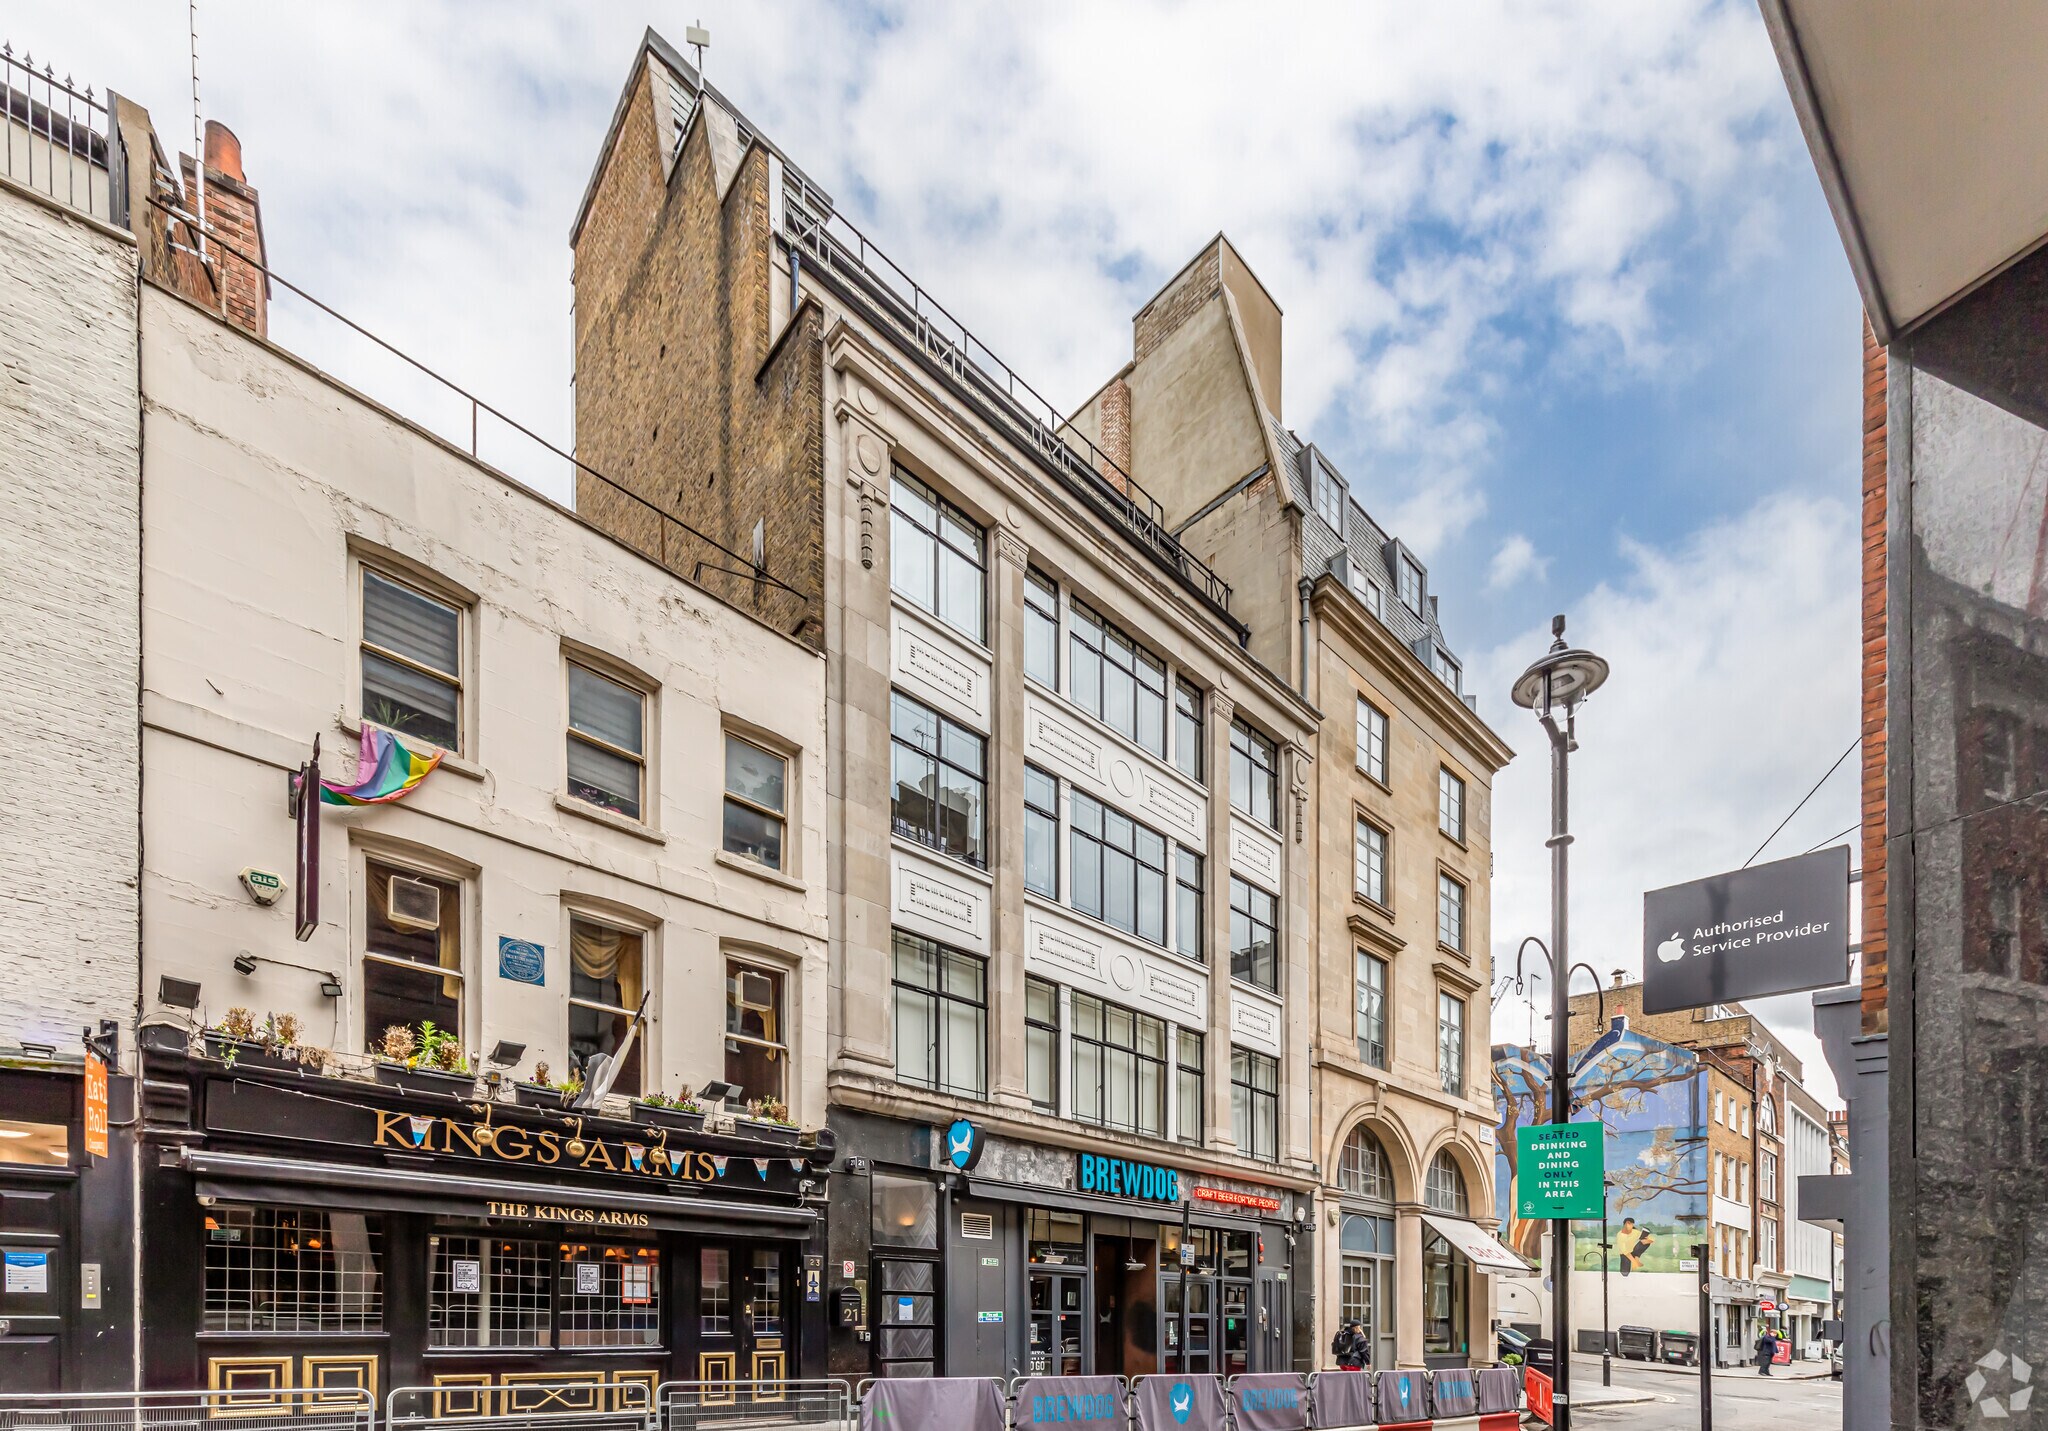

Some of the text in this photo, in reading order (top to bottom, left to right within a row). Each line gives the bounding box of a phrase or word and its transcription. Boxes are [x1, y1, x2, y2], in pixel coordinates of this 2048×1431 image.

[1693, 910, 1784, 940] Authorised
[1693, 922, 1830, 957] Service Provider
[87, 1074, 108, 1105] Kati
[88, 1106, 108, 1134] Roll
[373, 1109, 716, 1183] KINGS ARMS
[1531, 1141, 1587, 1151] DRINKING
[1538, 1131, 1579, 1141] SEATED
[1538, 1161, 1579, 1169] DINING
[1547, 1151, 1570, 1159] AND
[1081, 1153, 1179, 1201] BREWDOG
[1554, 1180, 1579, 1188] THIS
[1197, 1188, 1279, 1209] CRAFT BEER FOR THE PEOPLE
[1545, 1190, 1573, 1198] AREA
[486, 1202, 649, 1227] THE KINGS ARMS
[809, 1259, 820, 1267] 23
[844, 1308, 858, 1322] 21
[1035, 1361, 1046, 1371] GO
[1033, 1394, 1114, 1424] BREWDOG
[1241, 1388, 1299, 1411] BREWDOG
